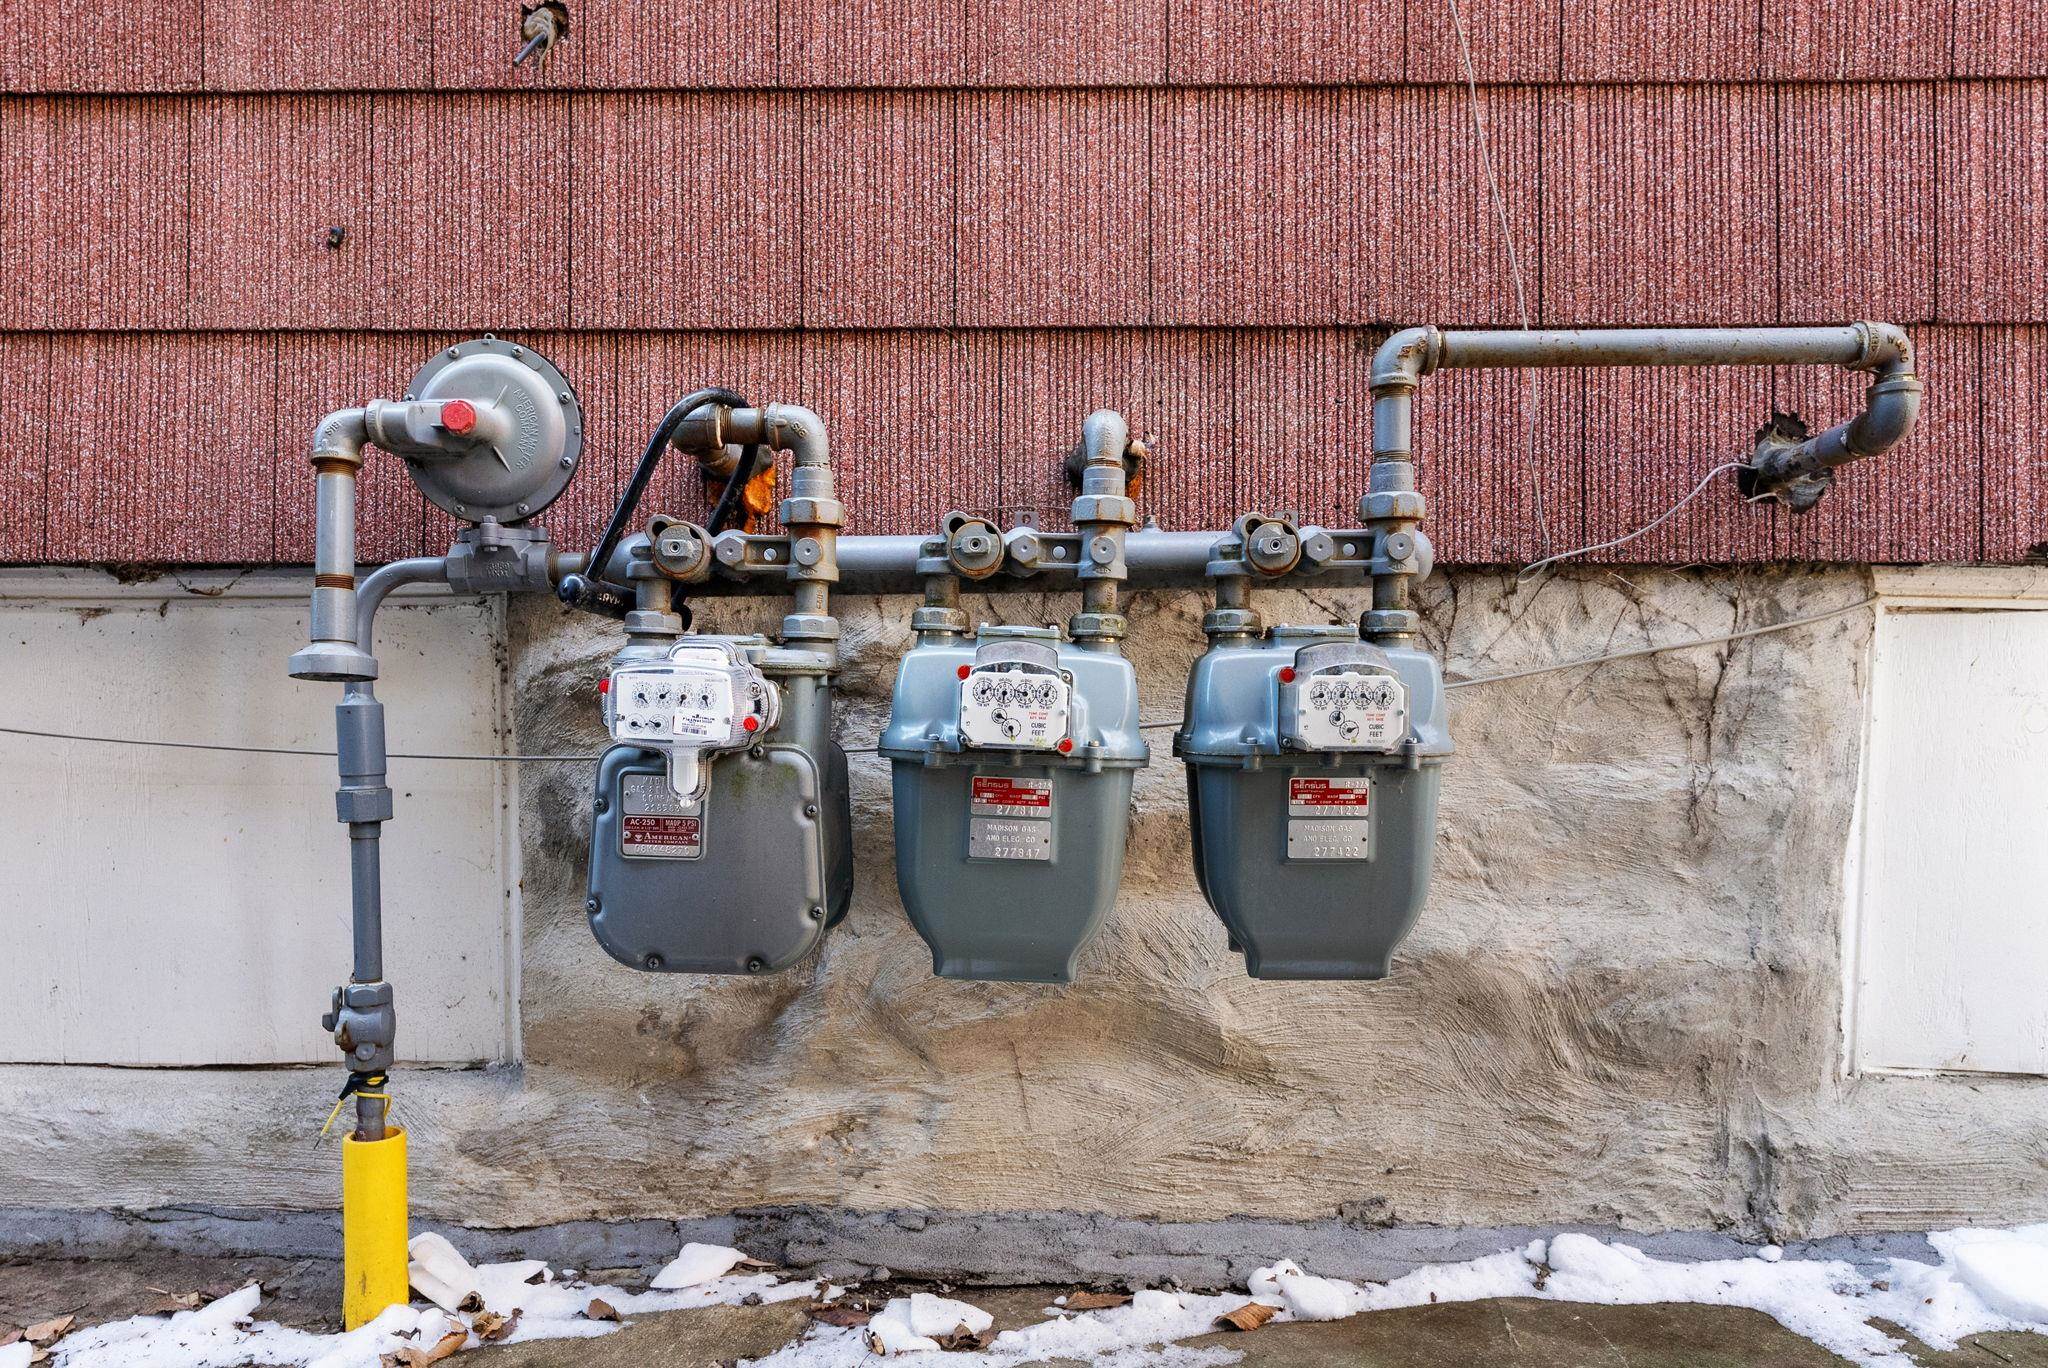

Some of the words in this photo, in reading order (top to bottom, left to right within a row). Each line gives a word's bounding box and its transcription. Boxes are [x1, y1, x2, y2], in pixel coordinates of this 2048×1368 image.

[513, 386, 540, 437] AMERICAN
[514, 403, 530, 454] COMPANY
[629, 818, 656, 826] AC-250
[986, 823, 1018, 832] MADISON
[1021, 825, 1037, 833] GAS
[1303, 824, 1335, 832] MADISON
[1338, 824, 1353, 832] GAS
[644, 832, 690, 841] AMERICAN
